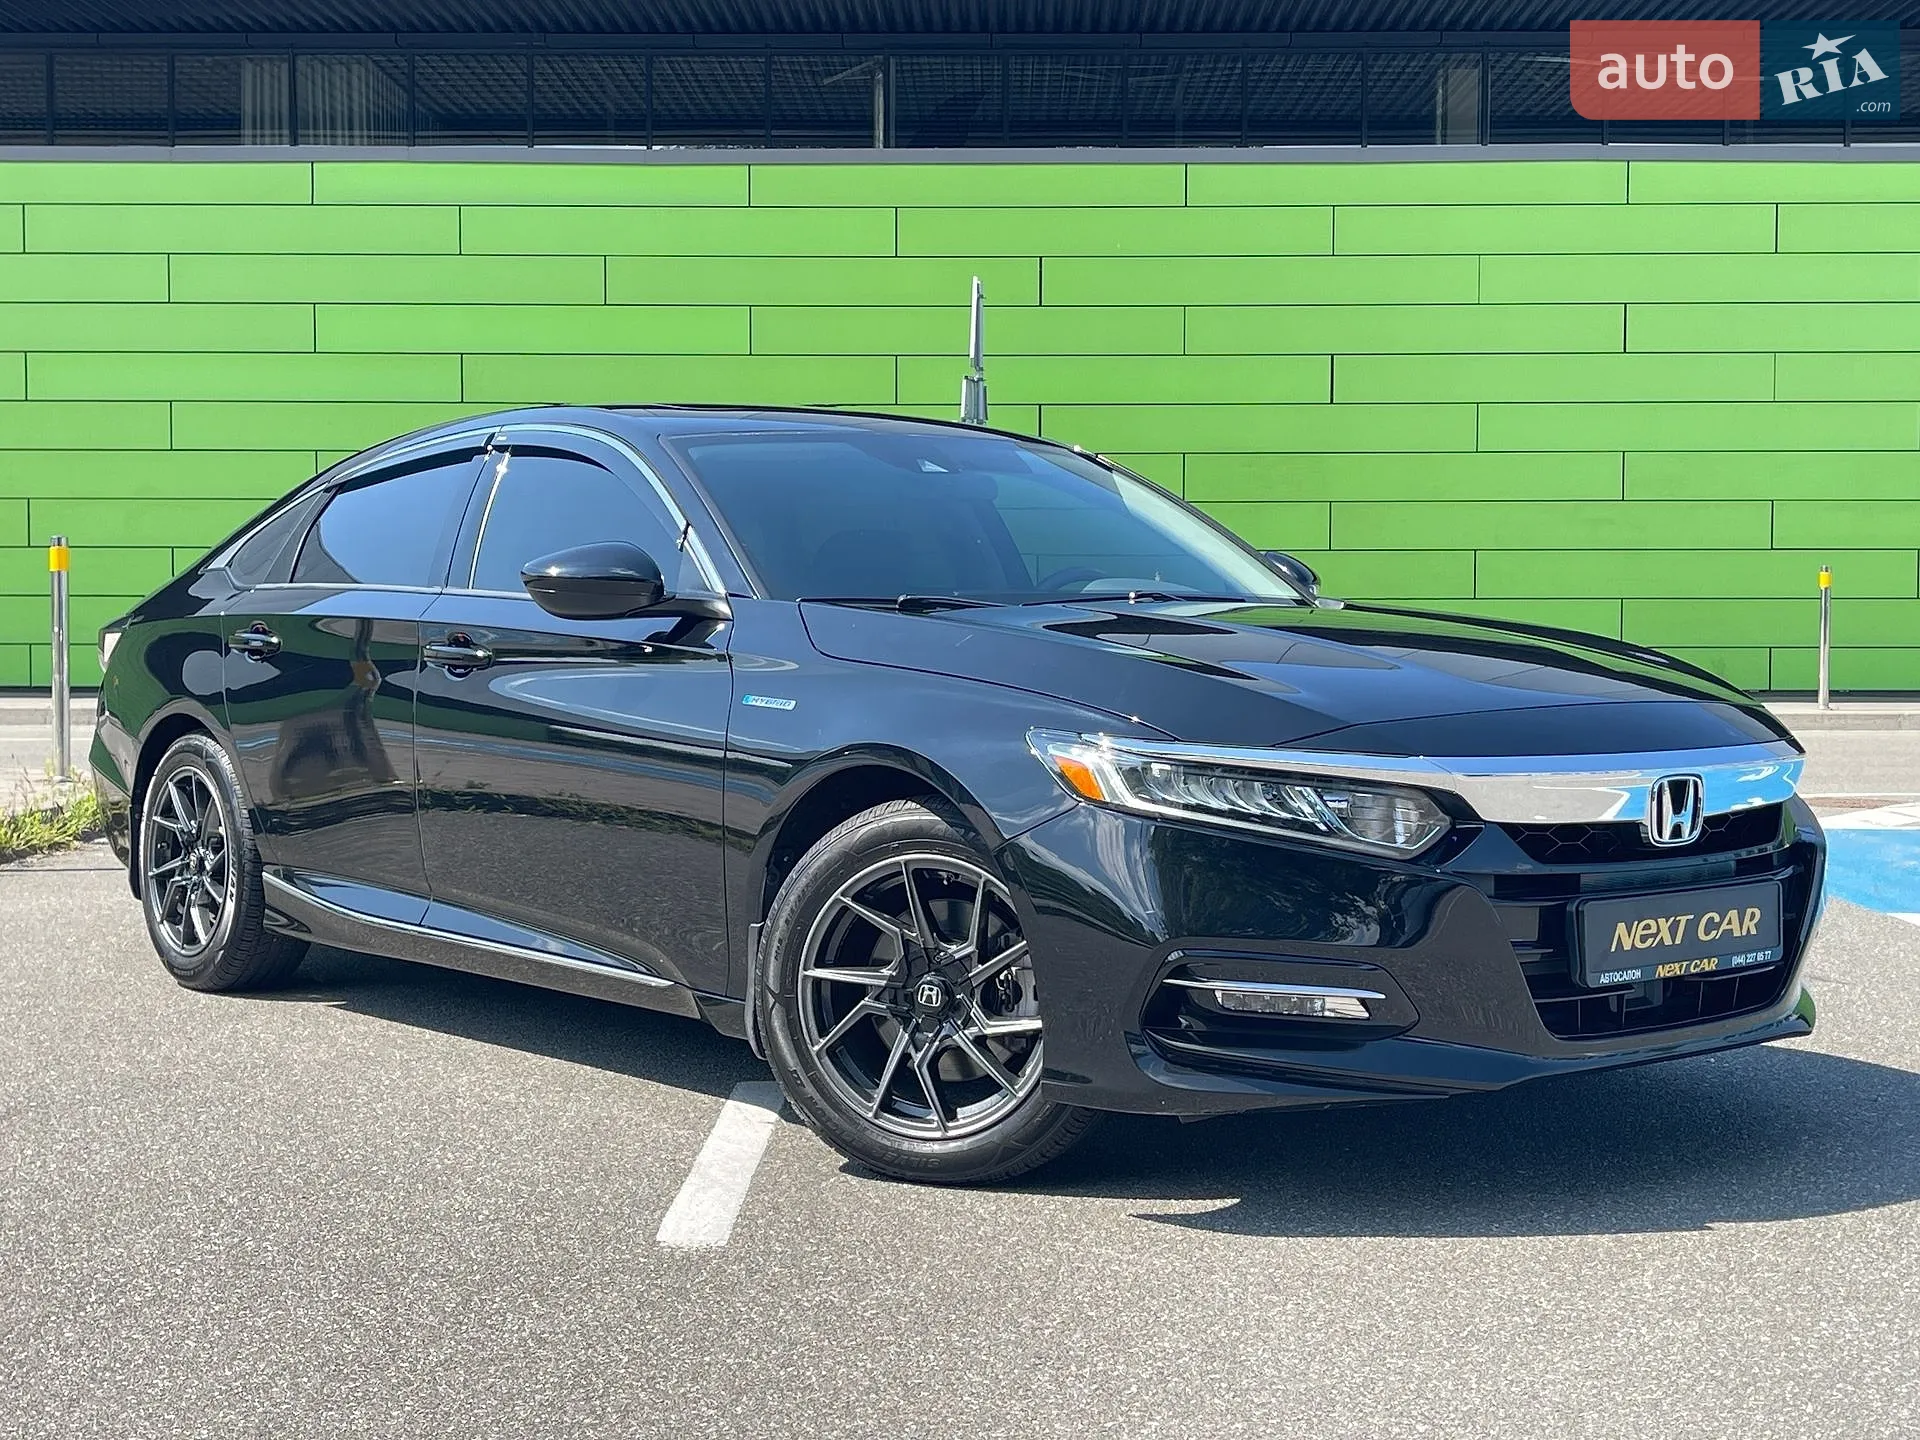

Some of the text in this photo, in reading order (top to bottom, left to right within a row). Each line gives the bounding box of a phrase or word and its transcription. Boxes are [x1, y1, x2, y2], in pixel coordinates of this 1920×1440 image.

[1697, 907, 1761, 942] CAR
[1690, 957, 1719, 973] CAR
[1599, 969, 1642, 984] АВТОСАЛОН
